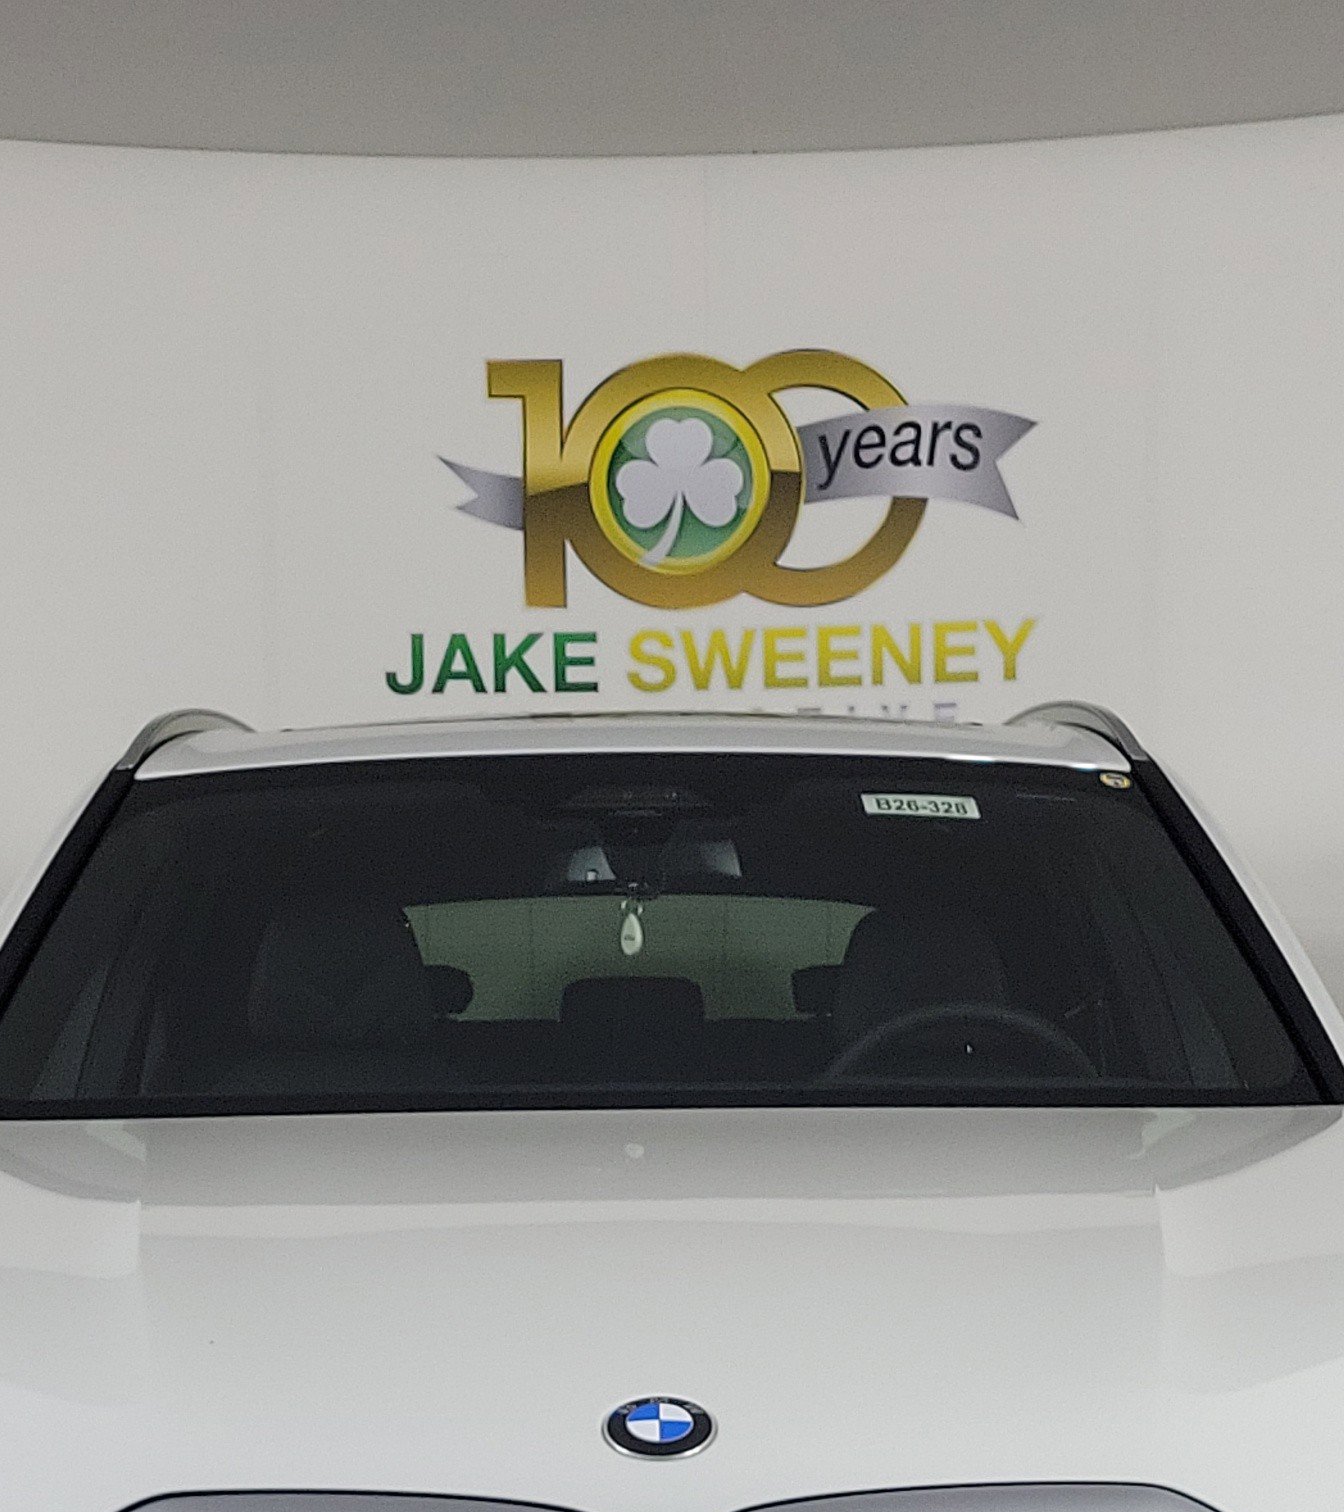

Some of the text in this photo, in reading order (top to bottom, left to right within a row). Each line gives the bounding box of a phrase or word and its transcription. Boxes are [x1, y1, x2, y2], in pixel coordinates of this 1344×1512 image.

[487, 348, 984, 609] 100 years
[386, 618, 1036, 695] JAKE SWEENEY
